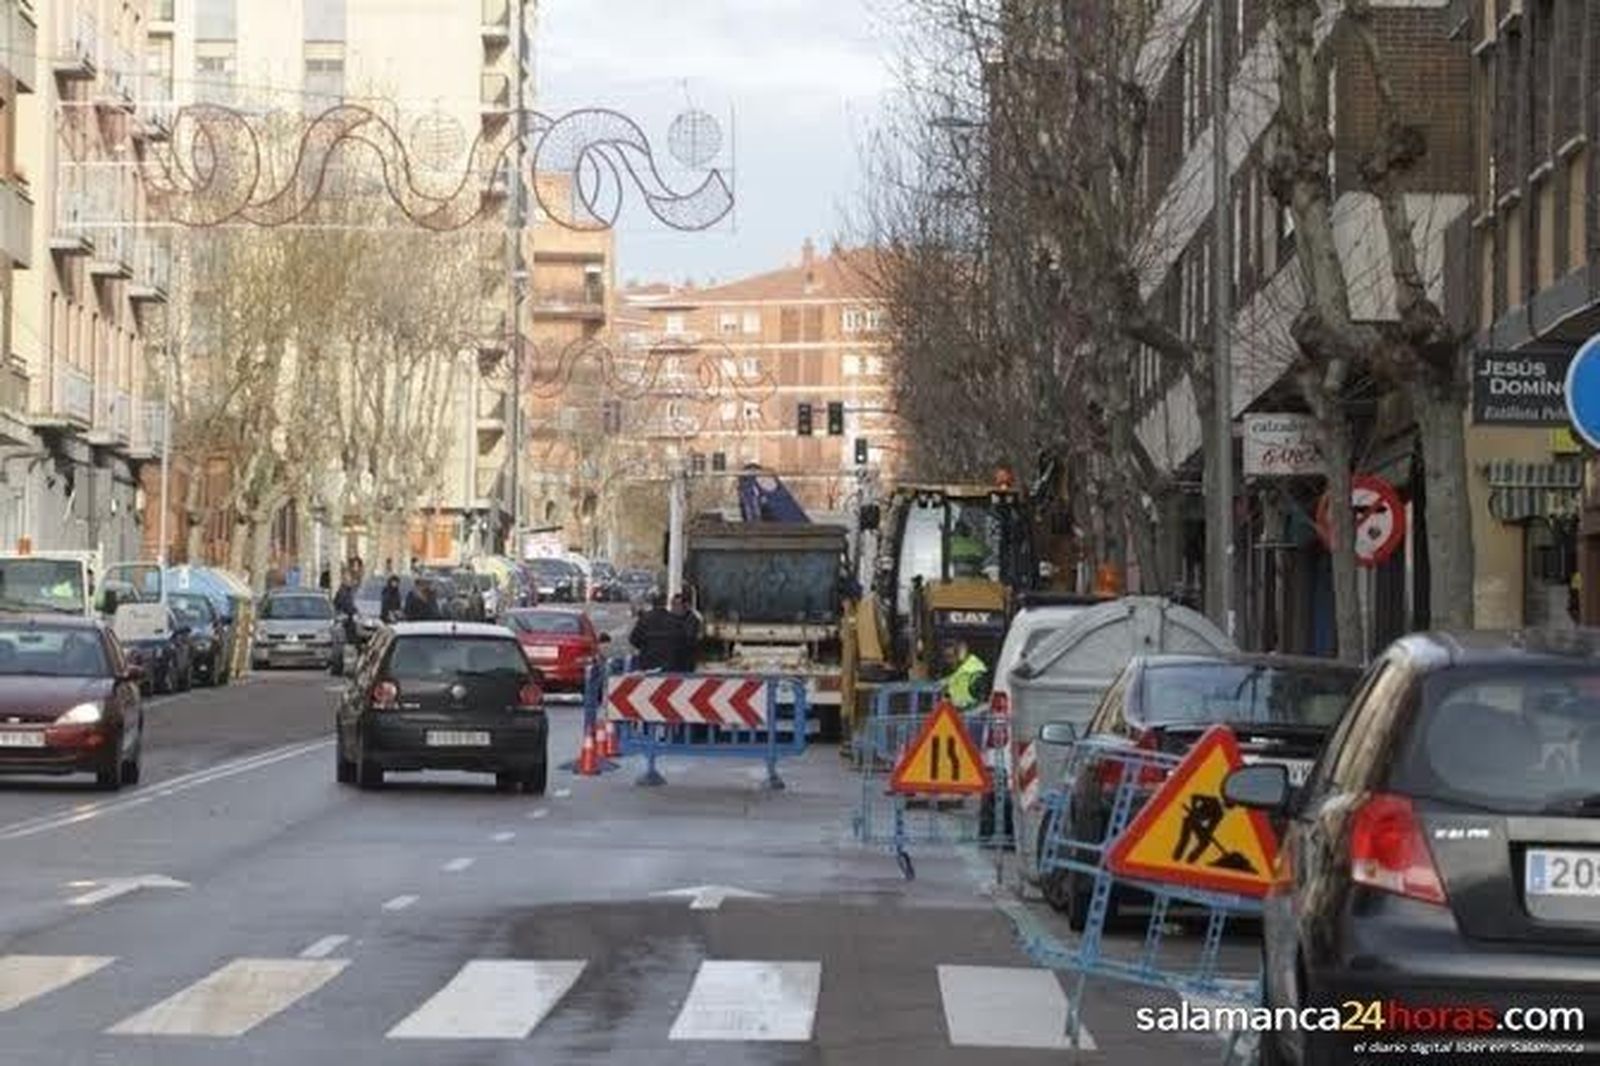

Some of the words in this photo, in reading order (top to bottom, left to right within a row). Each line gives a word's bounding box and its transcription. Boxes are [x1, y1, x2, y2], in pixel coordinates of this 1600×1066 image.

[1479, 358, 1547, 377] JESÚS
[1490, 377, 1566, 395] DOMÍN
[1551, 857, 1600, 889] 20
